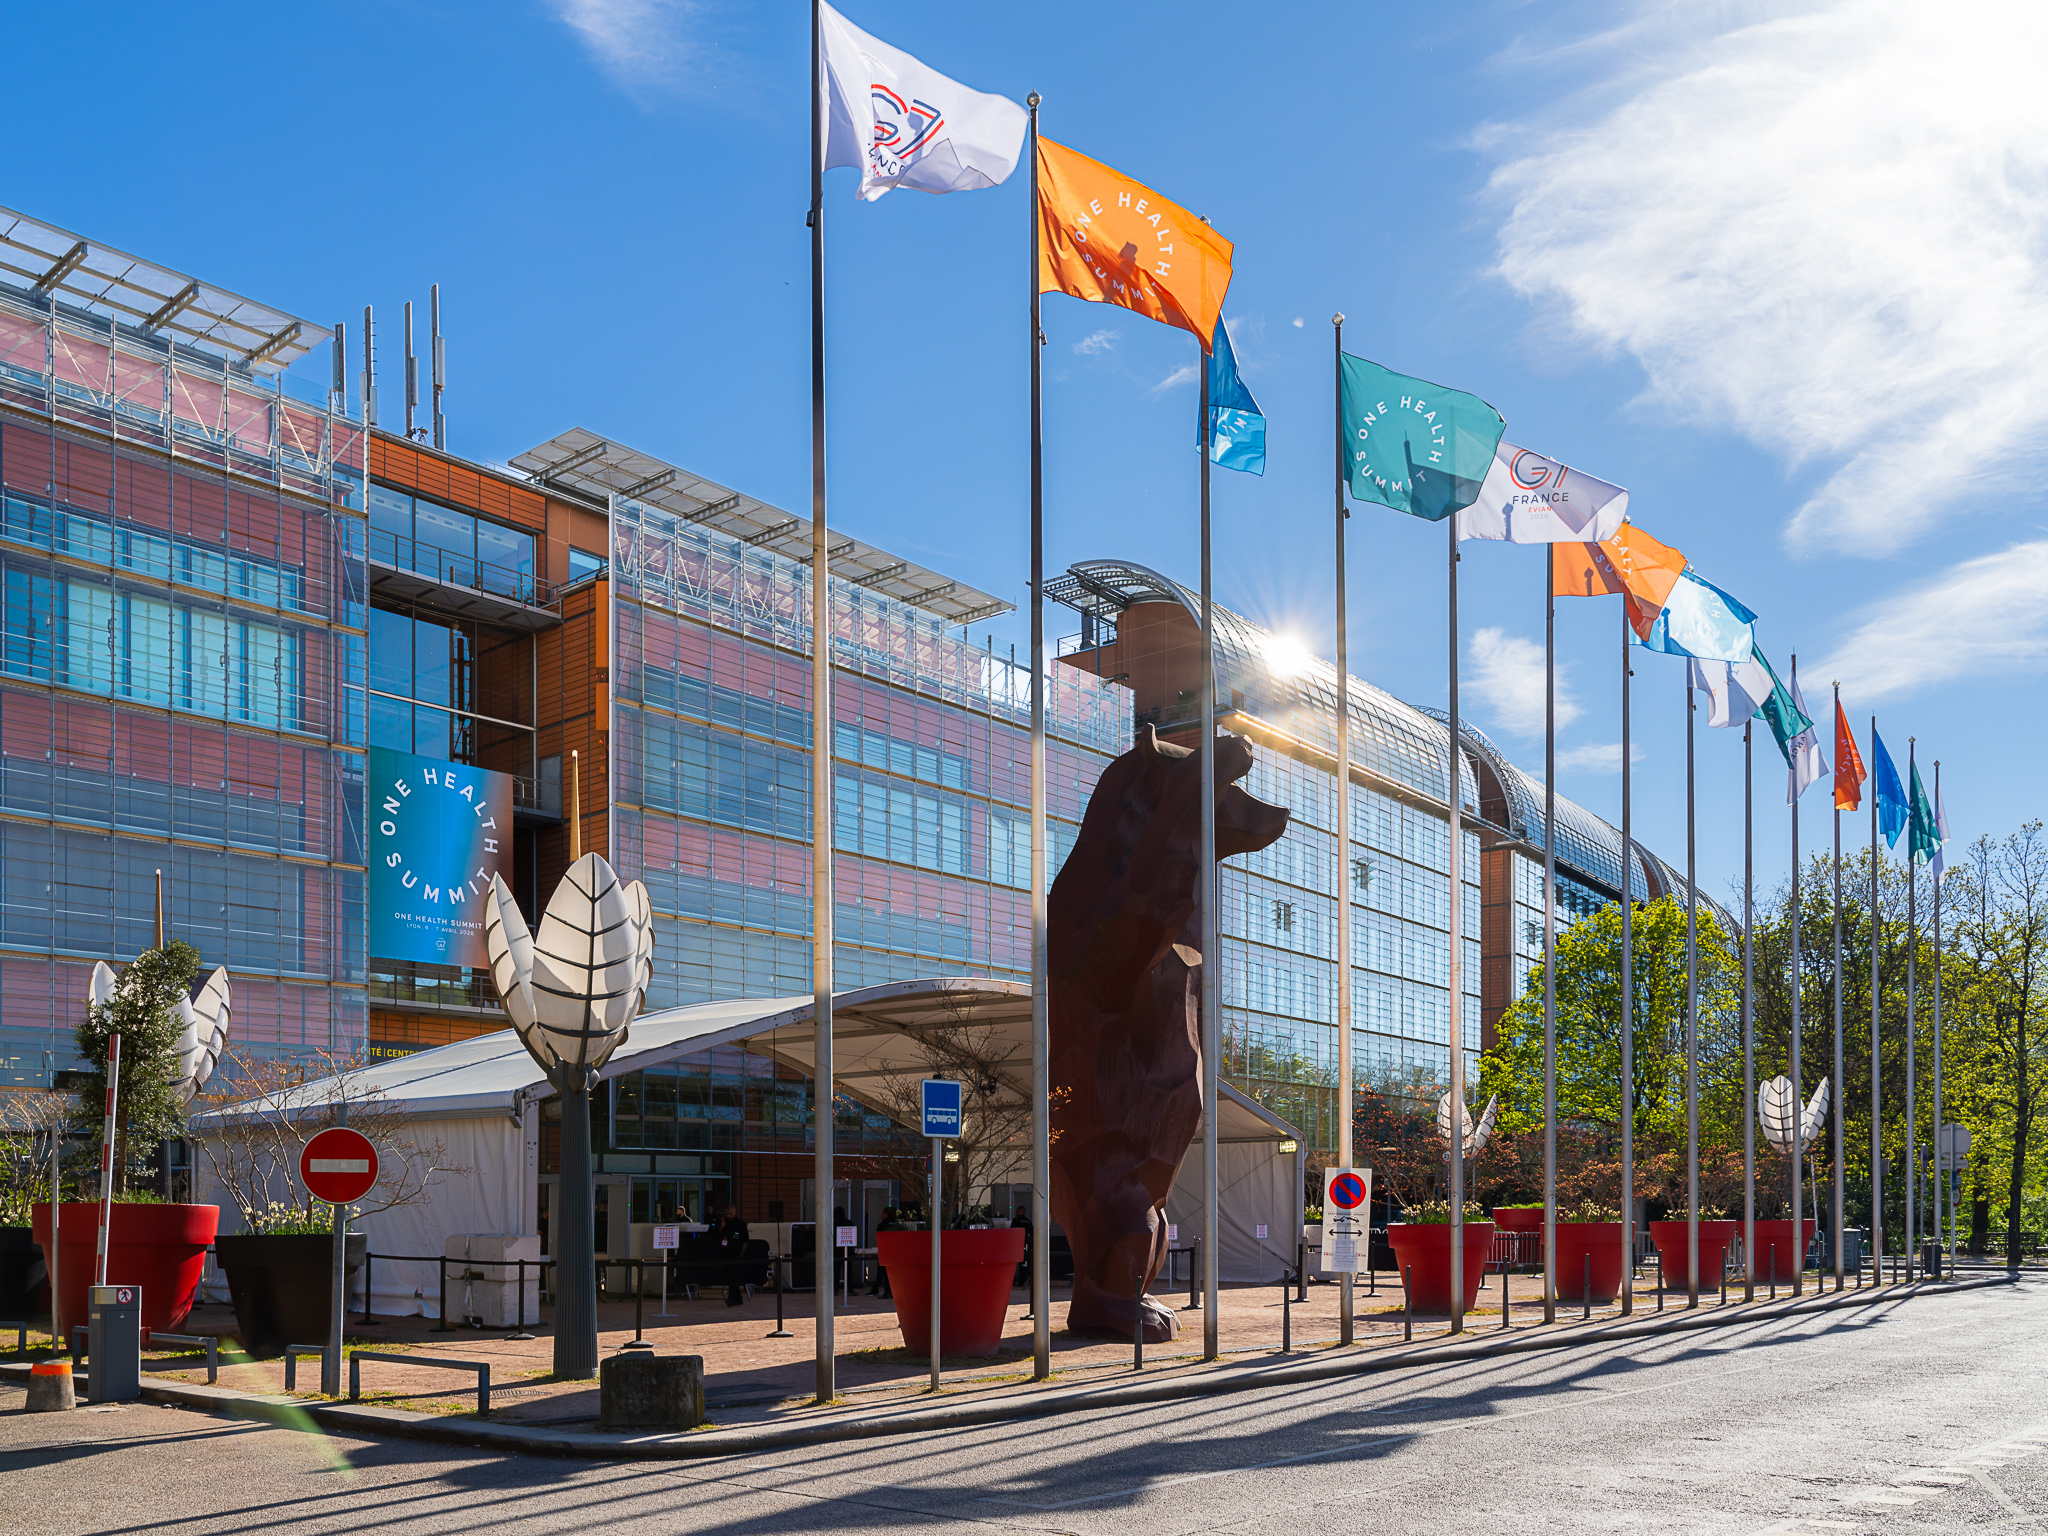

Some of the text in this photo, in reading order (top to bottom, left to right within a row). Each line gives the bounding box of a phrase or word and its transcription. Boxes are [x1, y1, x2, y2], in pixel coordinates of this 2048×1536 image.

[1075, 191, 1173, 276] ONE HEALTH
[1082, 253, 1162, 301] SUMMIT
[1358, 396, 1445, 463] ONE HEALTH
[1356, 450, 1426, 492] SUMMIT
[1512, 492, 1569, 505] FRANCE
[380, 768, 499, 853] ONE HEALTH
[386, 852, 491, 905] SUMMIT
[394, 912, 483, 930] ONE HEALTH SUMMIT
